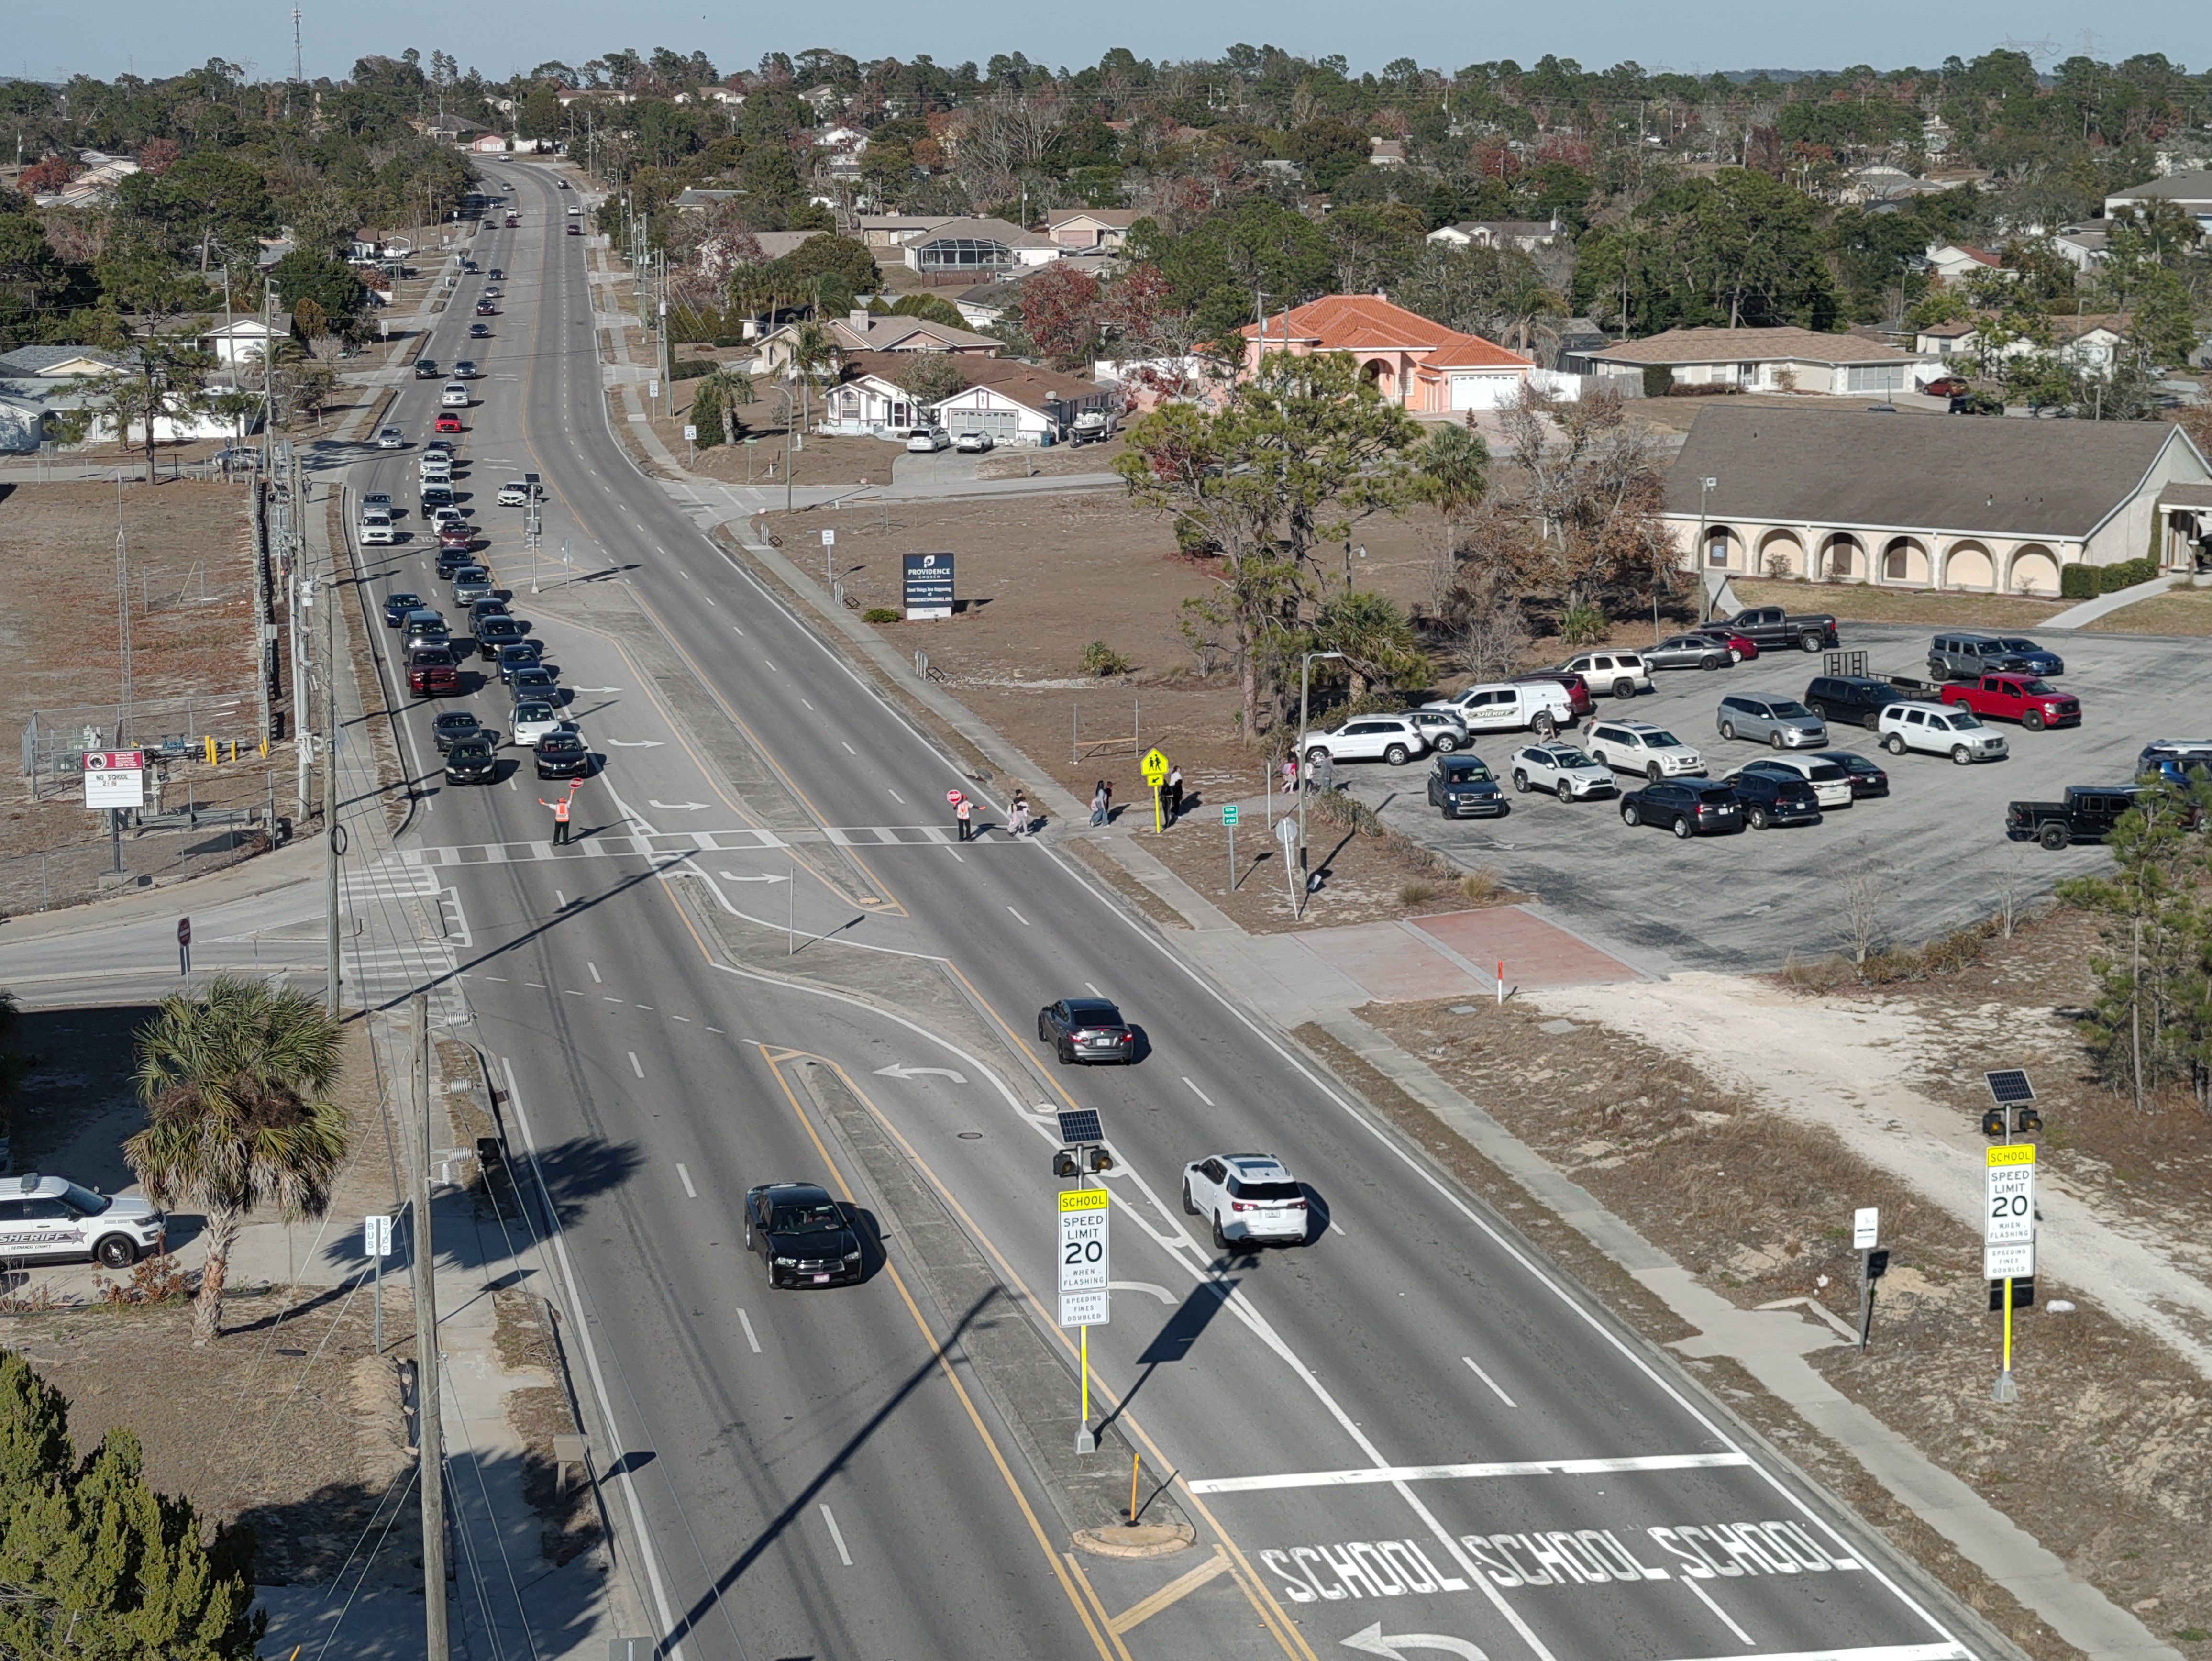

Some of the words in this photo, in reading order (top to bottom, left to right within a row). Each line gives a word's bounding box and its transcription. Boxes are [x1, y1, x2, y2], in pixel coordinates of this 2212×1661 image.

[1991, 1151, 2031, 1163] SCHOOL
[1991, 1170, 2030, 1182] SPEED
[1995, 1183, 2025, 1194] LIMIT
[1062, 1195, 1104, 1207] SCHOOL
[1992, 1195, 2028, 1218] 20
[1064, 1216, 1104, 1227] SPEED
[0, 1233, 65, 1243] SHERIFF
[1068, 1229, 1099, 1240] LIMIT
[1990, 1230, 2028, 1239] FLASHING
[1065, 1240, 1102, 1264] 20
[1064, 1277, 1104, 1286] FLASHING
[1066, 1296, 1101, 1304] SPEEDING
[1067, 1313, 1101, 1321] DOUBLED
[1648, 1520, 1864, 1579] SCHOOL
[1460, 1529, 1670, 1588] SCHOOL
[1259, 1539, 1469, 1603] SCHOOL
